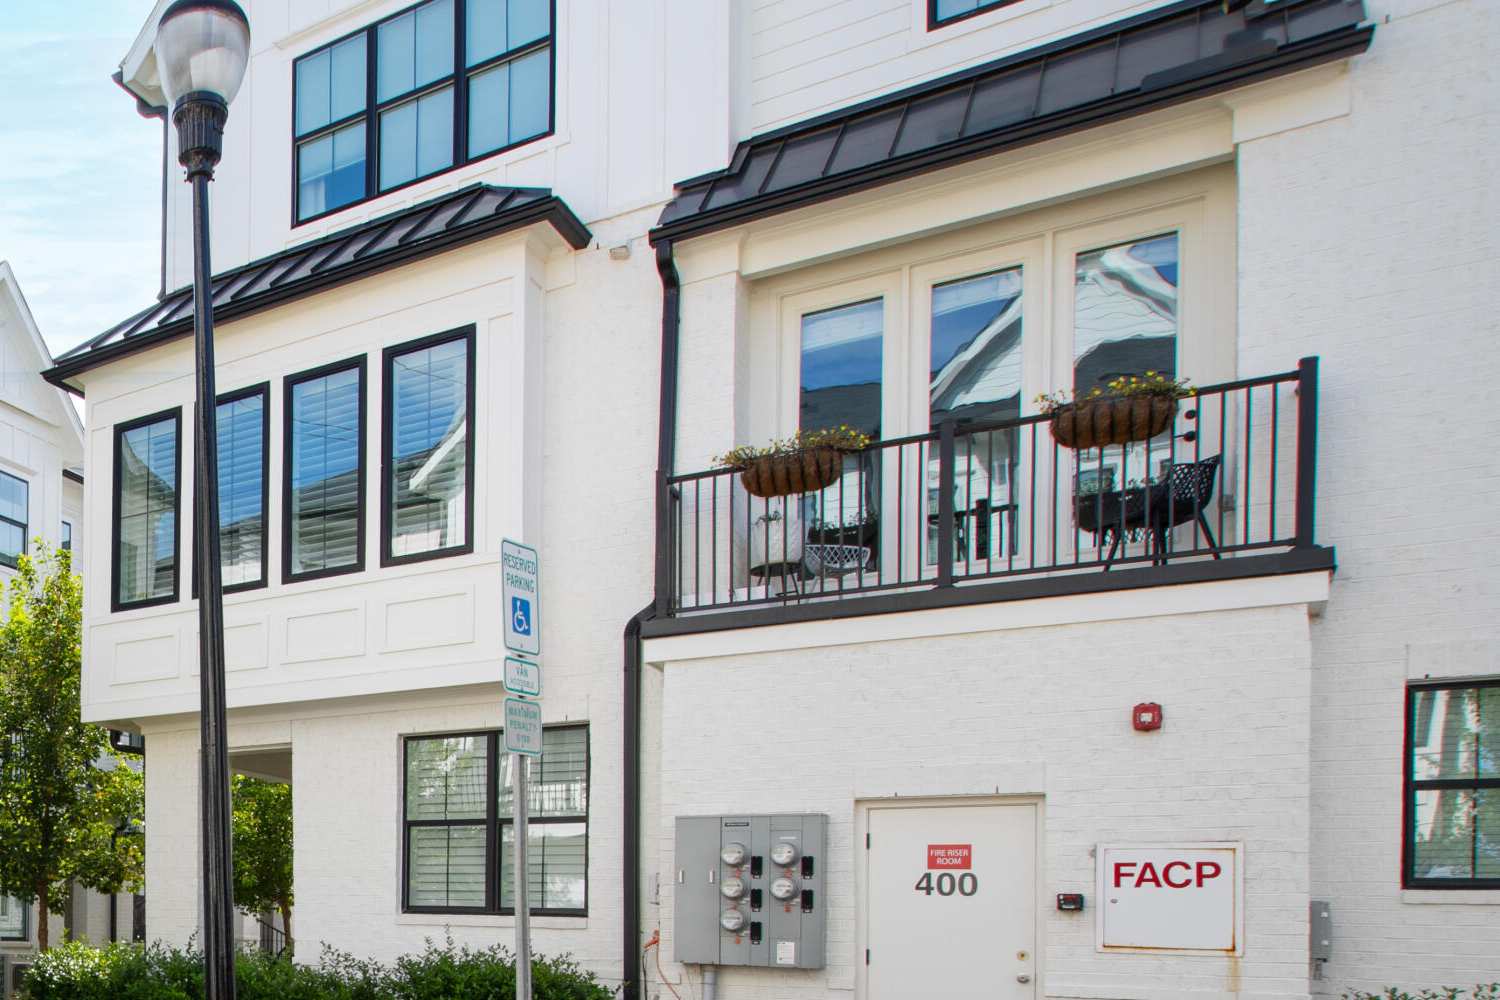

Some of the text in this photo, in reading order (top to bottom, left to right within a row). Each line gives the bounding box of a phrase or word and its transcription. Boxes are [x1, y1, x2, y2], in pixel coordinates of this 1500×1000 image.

[503, 552, 536, 576] RESERVED
[506, 571, 535, 593] PARKING
[515, 665, 529, 679] VAN
[930, 849, 969, 857] FIRE RISER
[936, 857, 962, 865] ROOM
[914, 872, 979, 897] 400
[1113, 861, 1222, 889] FACP
